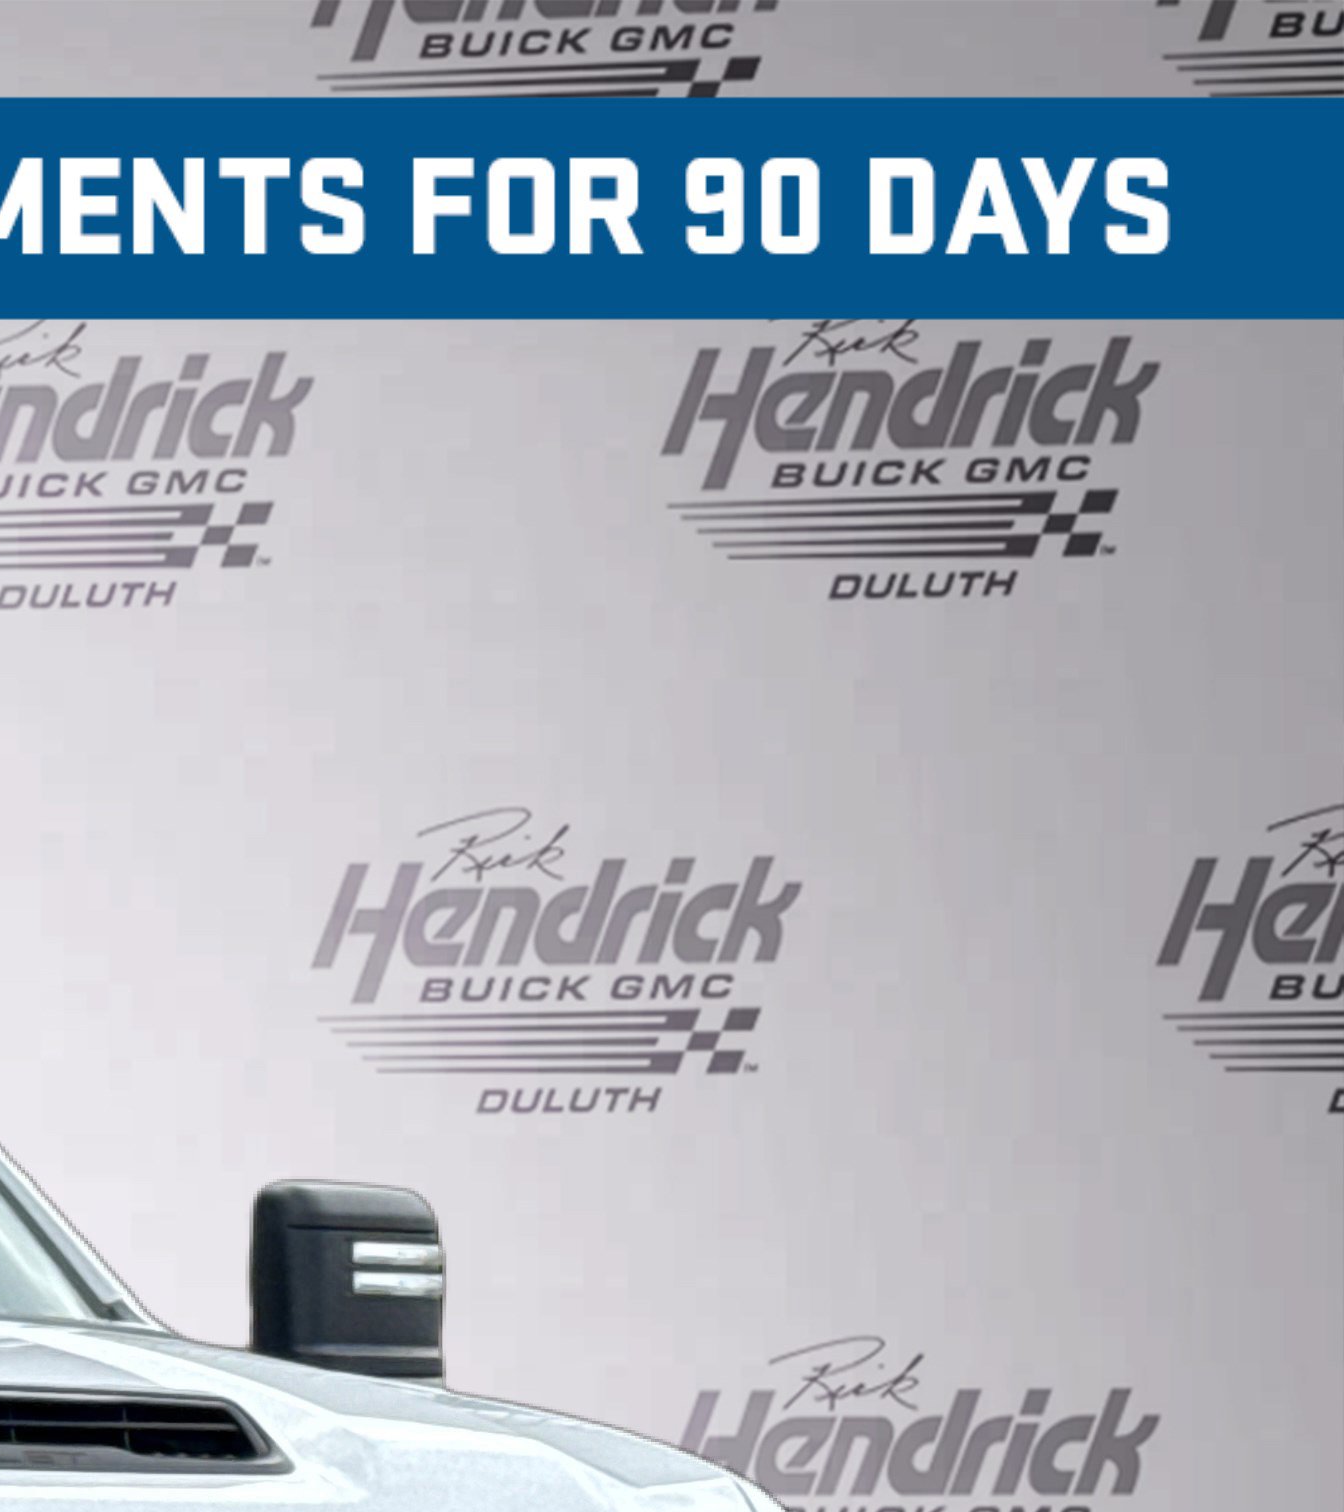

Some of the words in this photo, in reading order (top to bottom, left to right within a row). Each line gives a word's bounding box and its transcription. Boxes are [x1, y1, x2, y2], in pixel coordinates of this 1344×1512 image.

[419, 27, 592, 60] BUICK
[610, 23, 735, 53] GMC
[660, 336, 1161, 490] Hendrick
[125, 468, 248, 496] GMC
[770, 458, 946, 488] BUICK
[964, 455, 1092, 483] GMC
[828, 570, 1019, 601] DULUTH
[416, 807, 571, 884] Rick
[311, 856, 802, 1005] Hendrick
[418, 974, 593, 1004] BUICK
[611, 972, 736, 1001] GMC
[475, 1087, 663, 1115] DULUTH
[768, 1335, 924, 1411] Rick
[675, 1387, 1162, 1497] Hendrick
